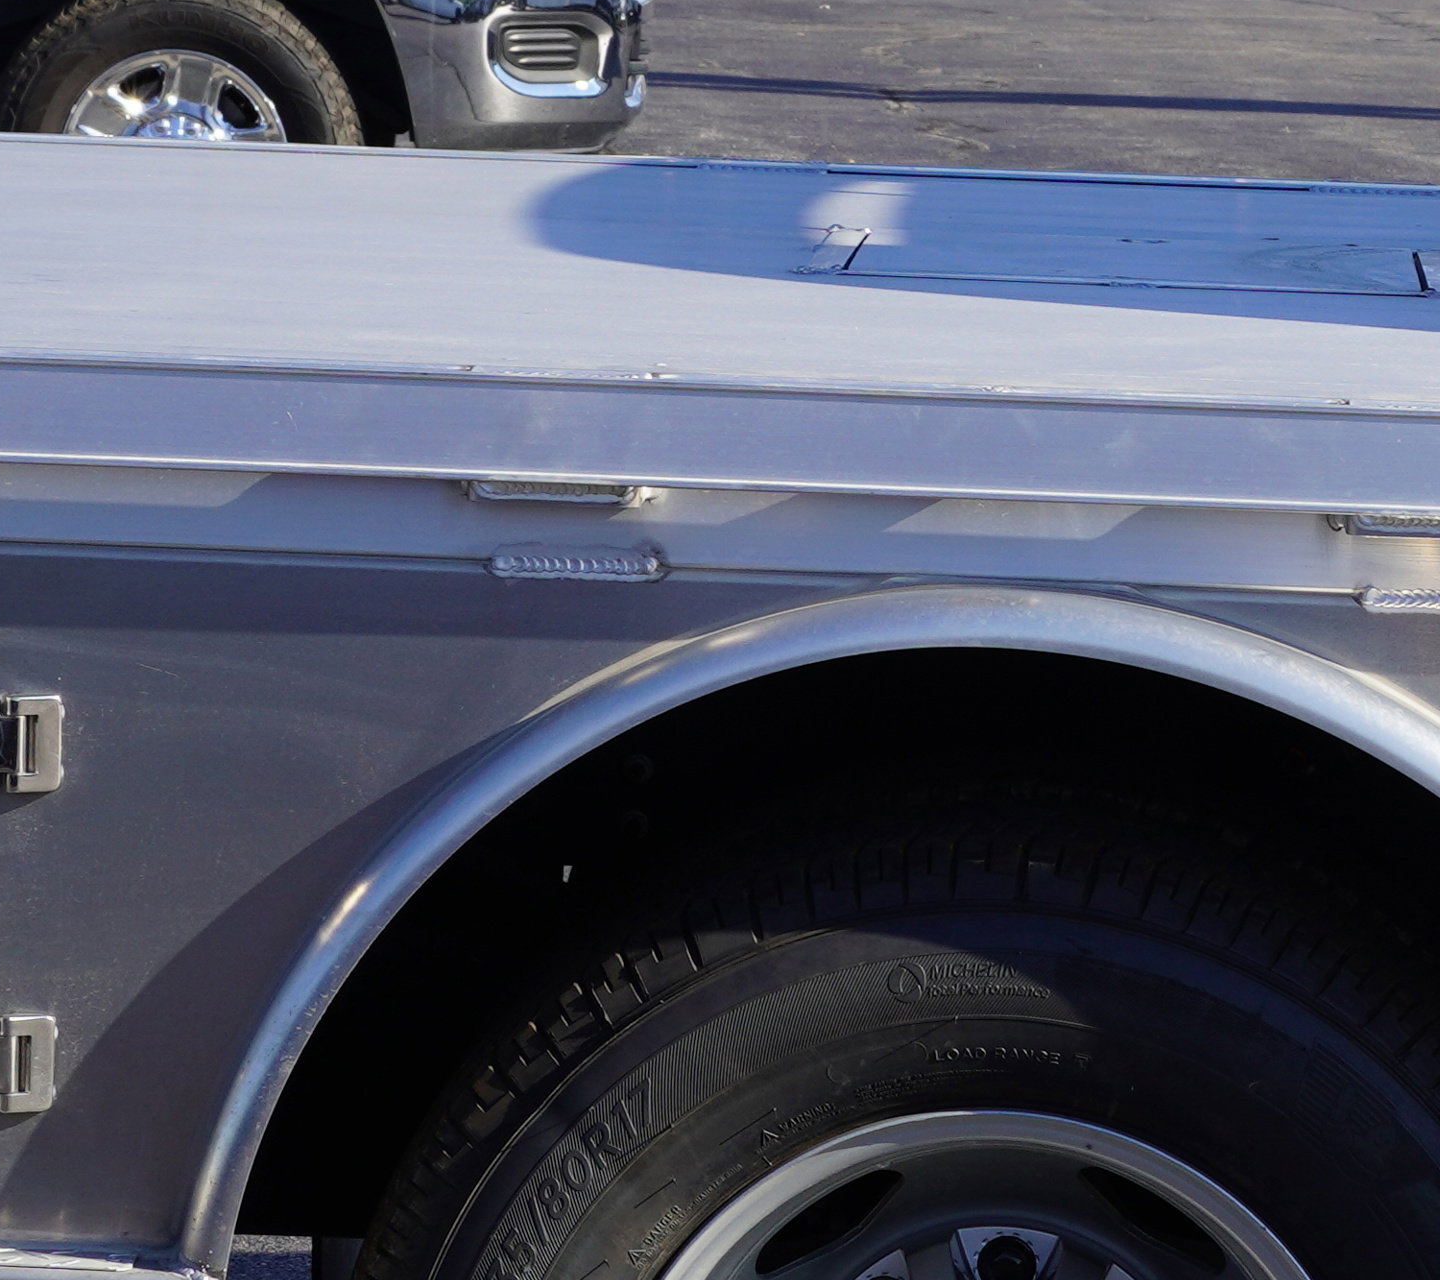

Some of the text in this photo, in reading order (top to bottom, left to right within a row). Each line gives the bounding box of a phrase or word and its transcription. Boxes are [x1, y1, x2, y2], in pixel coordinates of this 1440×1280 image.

[927, 960, 1019, 980] MICHELIN
[933, 1045, 986, 1063] LOAD
[994, 1045, 1061, 1065] RANGE
